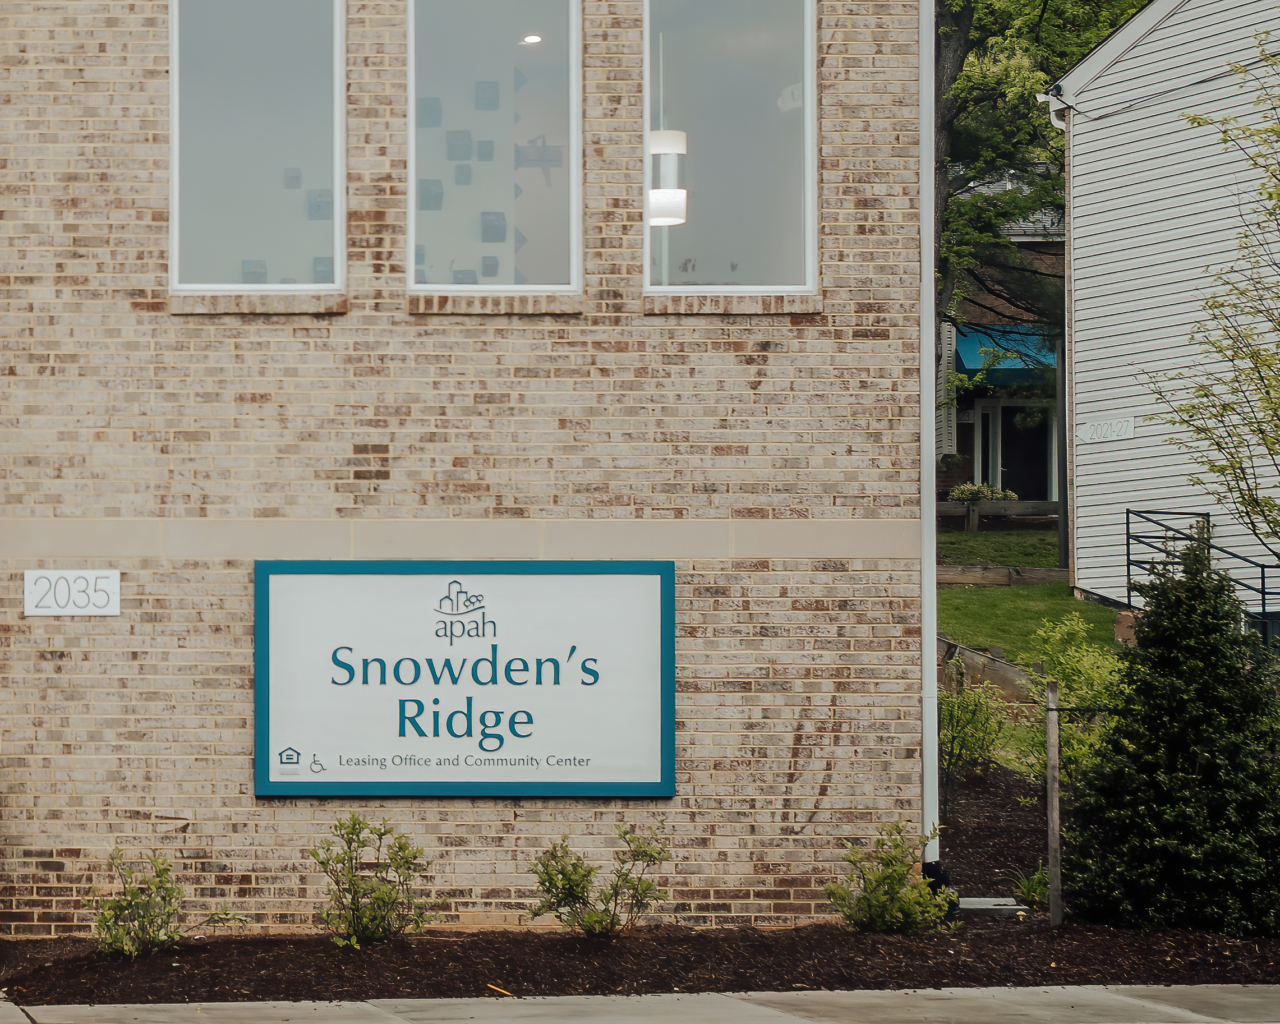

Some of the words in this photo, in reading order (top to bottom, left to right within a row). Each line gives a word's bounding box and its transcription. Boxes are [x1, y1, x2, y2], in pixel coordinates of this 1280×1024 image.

[1089, 420, 1129, 439] 2021-27
[33, 576, 110, 609] 2035
[434, 611, 498, 646] apah
[330, 643, 600, 686] Snowden's
[397, 696, 534, 752] Ridge
[339, 754, 387, 770] Leasing
[391, 754, 431, 767] Office
[435, 754, 460, 767] and
[464, 754, 541, 770] Community
[546, 754, 591, 767] Center
